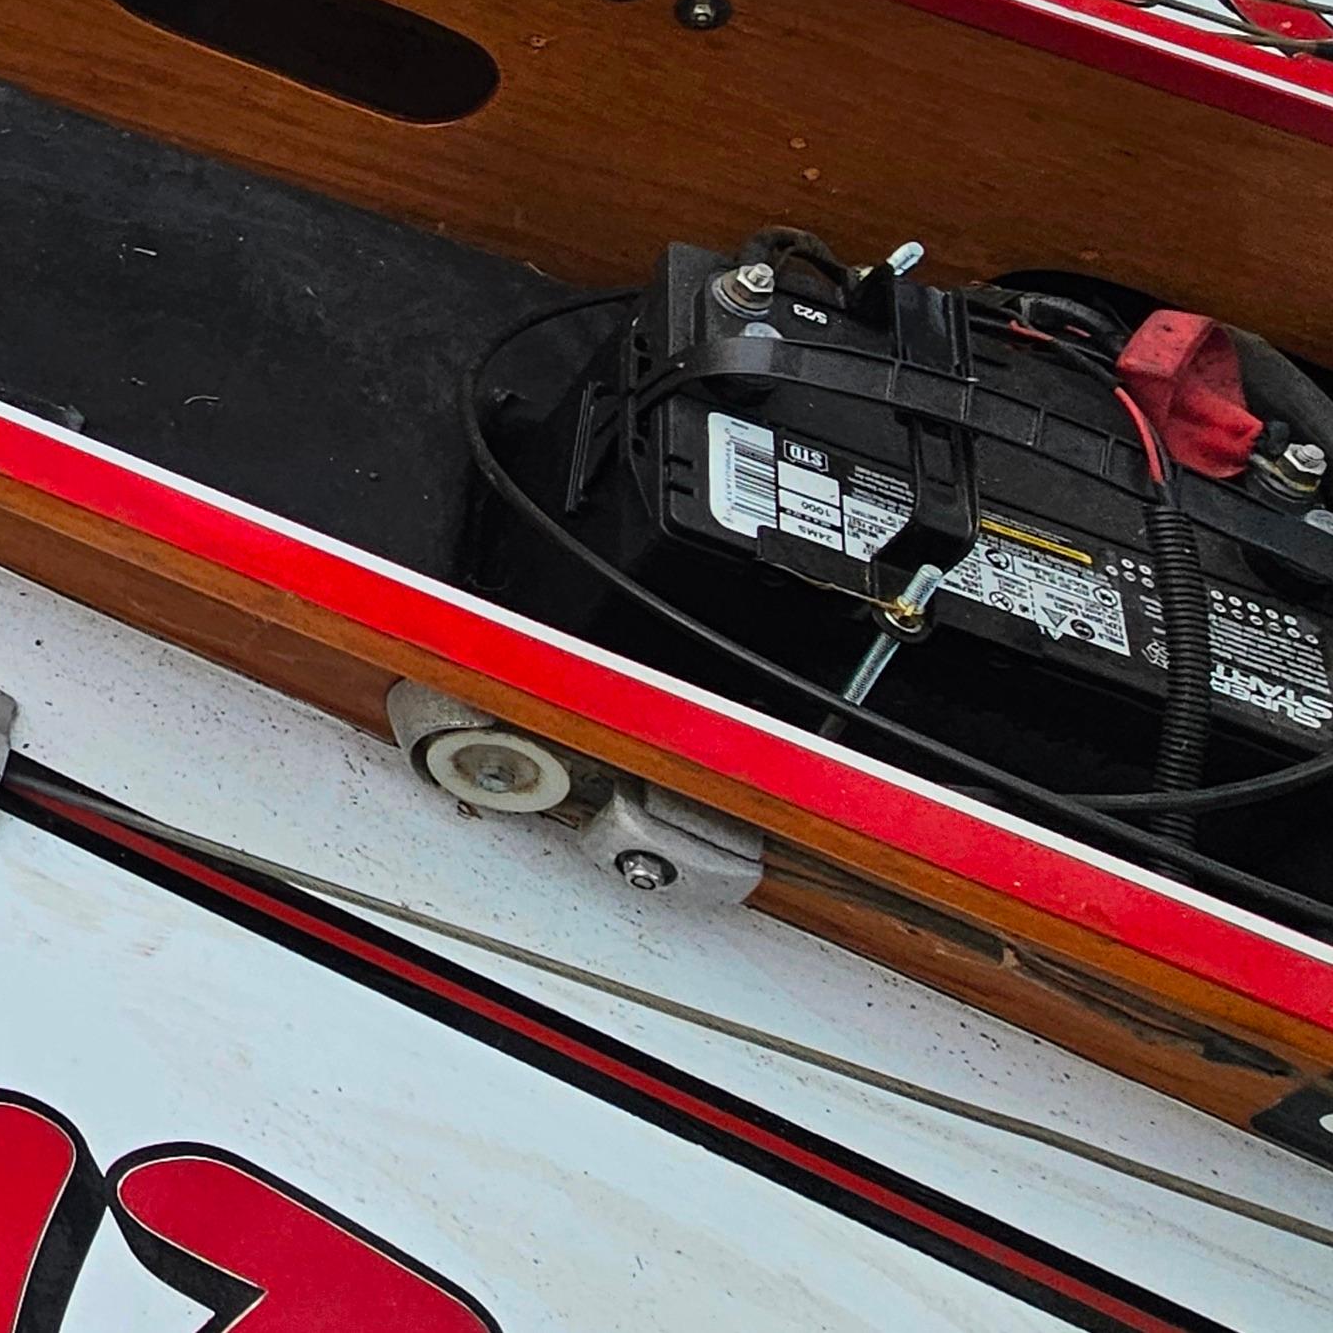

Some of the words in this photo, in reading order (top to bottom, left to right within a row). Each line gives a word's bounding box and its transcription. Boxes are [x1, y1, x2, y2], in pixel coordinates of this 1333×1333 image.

[789, 445, 824, 467] STD
[800, 500, 831, 517] 1000
[1209, 678, 1321, 729] SUPER
[1210, 663, 1333, 720] START
